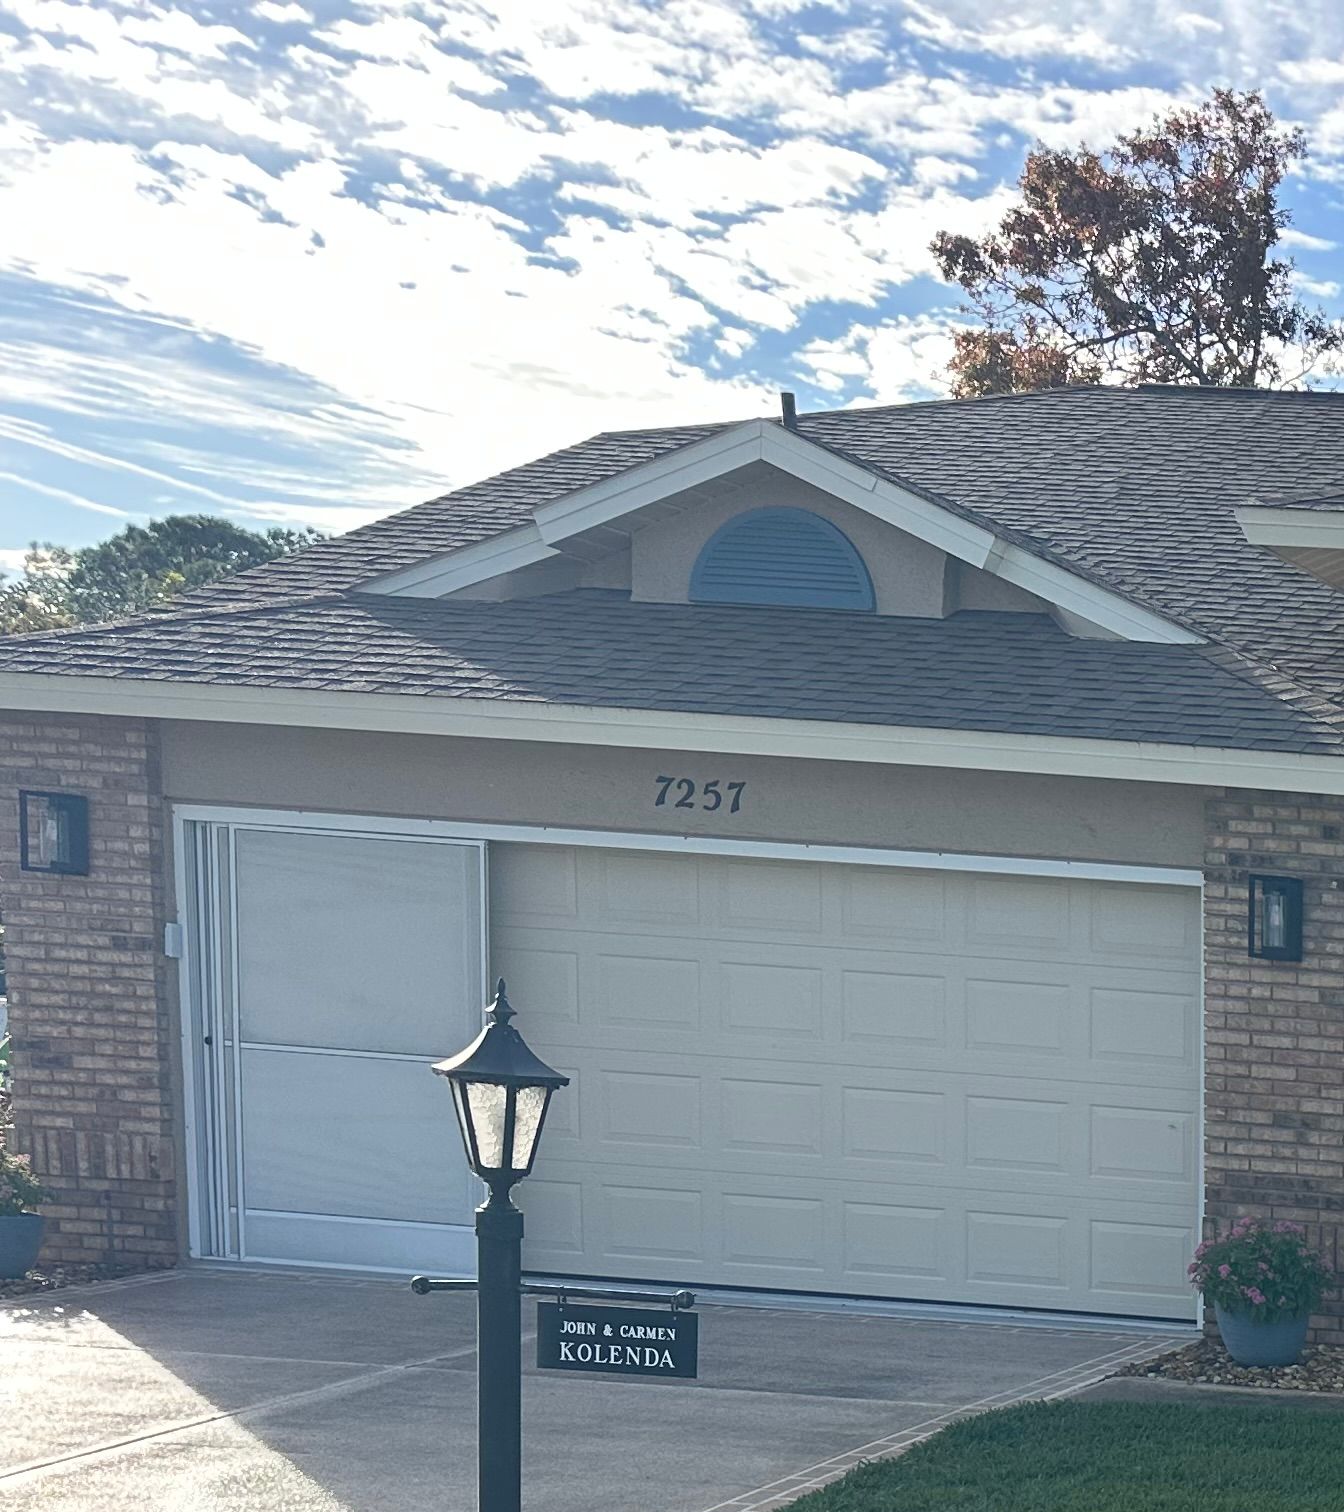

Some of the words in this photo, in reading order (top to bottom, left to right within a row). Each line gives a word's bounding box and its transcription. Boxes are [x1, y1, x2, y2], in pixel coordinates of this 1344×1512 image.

[655, 775, 747, 813] 7257
[560, 1321, 597, 1335] JOHN
[603, 1324, 613, 1337] &
[620, 1325, 676, 1341] CARMEN
[560, 1342, 675, 1368] KOLENDA
